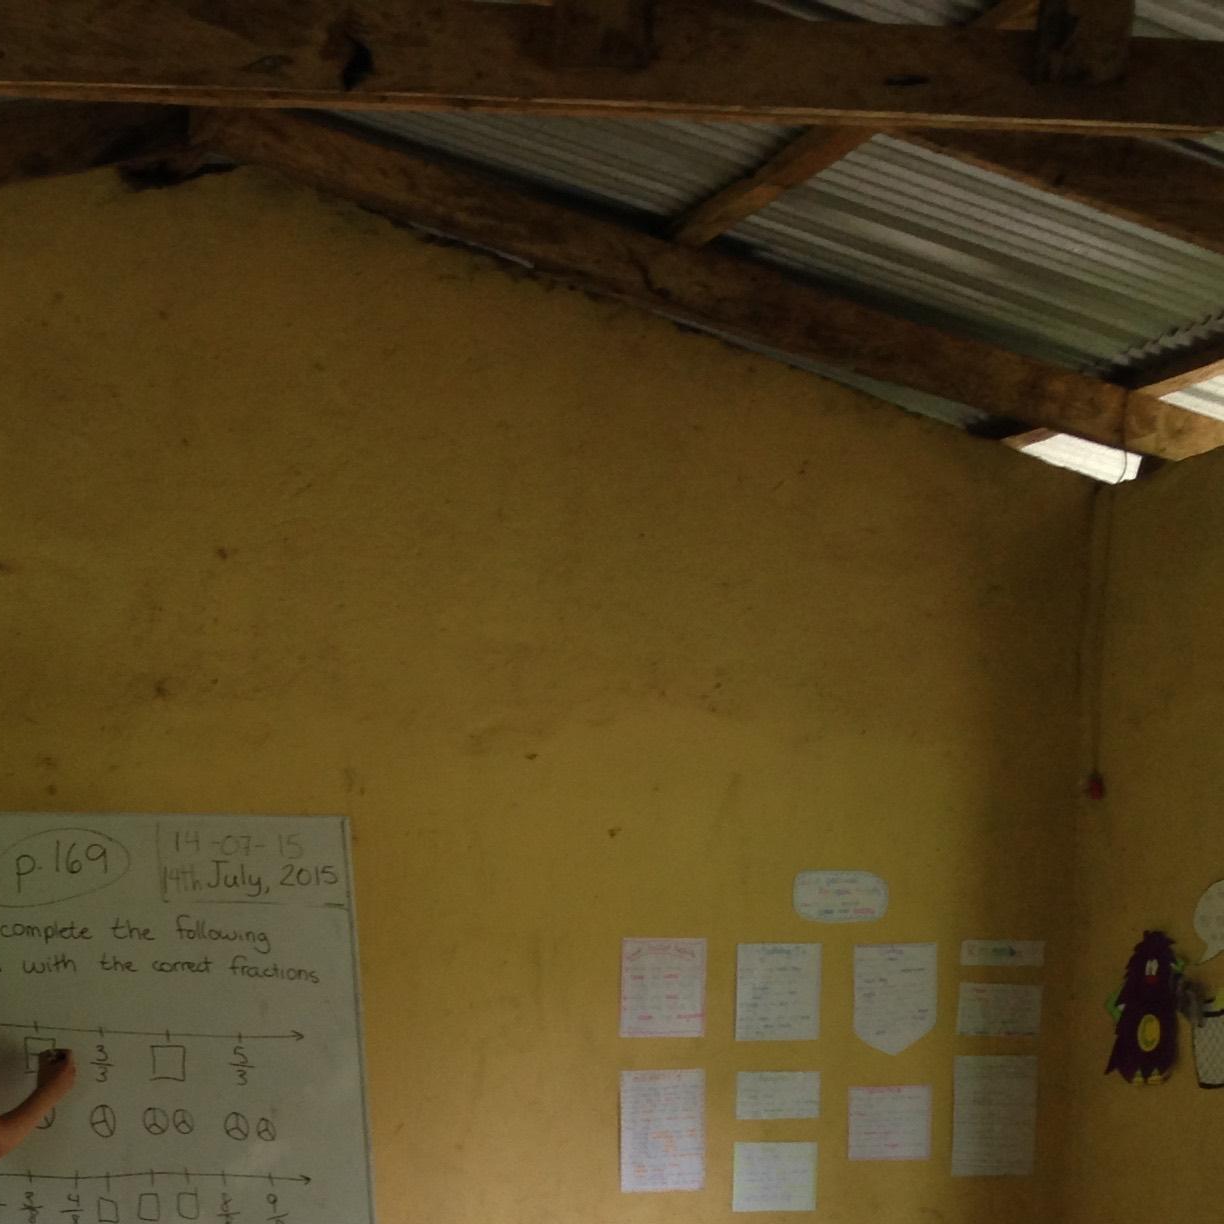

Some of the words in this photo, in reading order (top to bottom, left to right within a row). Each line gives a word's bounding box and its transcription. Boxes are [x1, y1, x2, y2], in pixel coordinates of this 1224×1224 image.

[207, 859, 270, 898] July,
[279, 863, 339, 887] 2015
[0, 920, 94, 944] complete
[112, 917, 156, 941] the
[175, 913, 272, 955] following
[21, 953, 77, 974] with
[99, 952, 139, 973] the
[151, 956, 214, 974] correct
[228, 954, 321, 984] fractions
